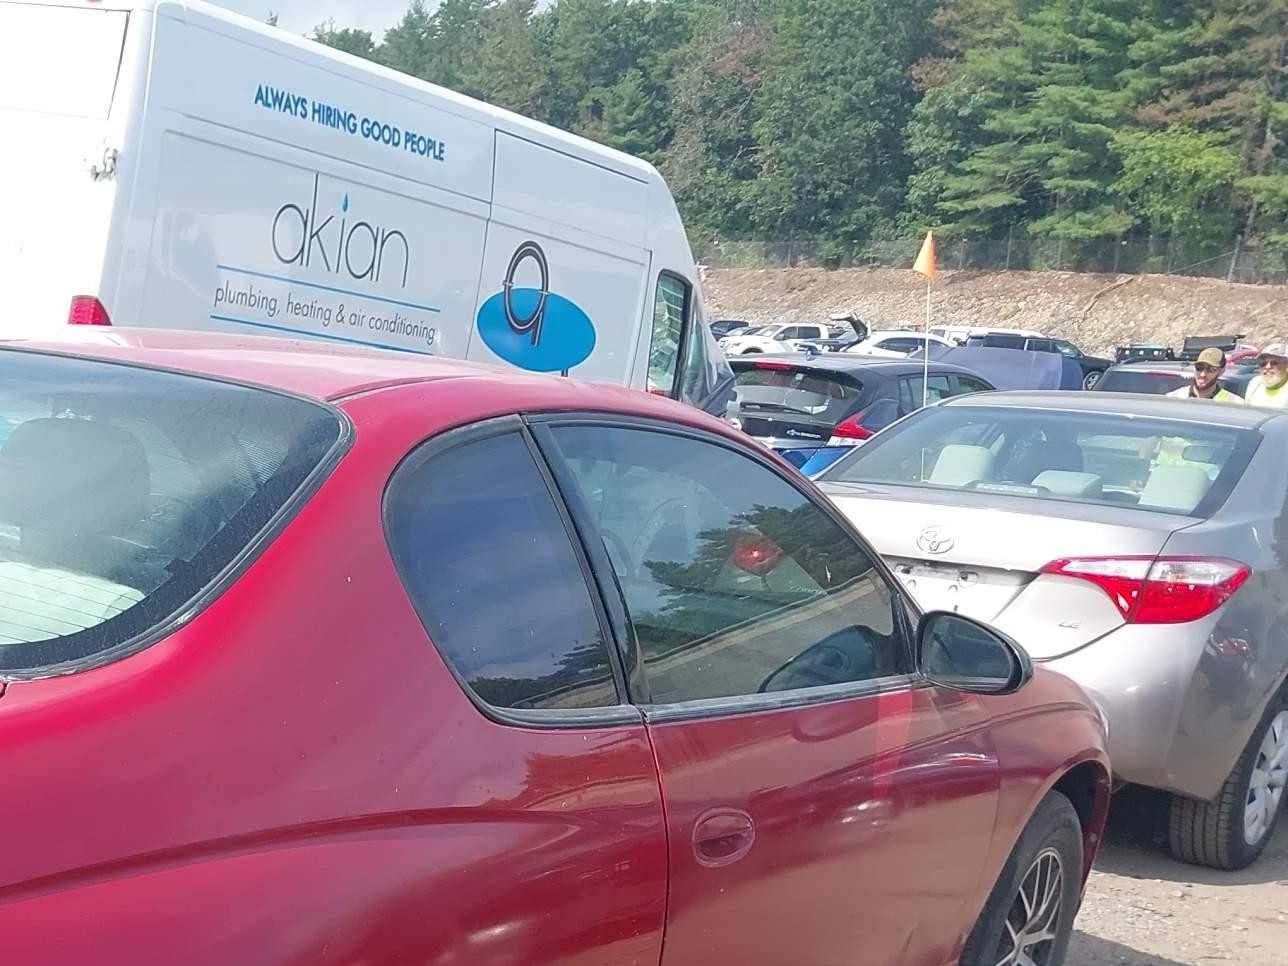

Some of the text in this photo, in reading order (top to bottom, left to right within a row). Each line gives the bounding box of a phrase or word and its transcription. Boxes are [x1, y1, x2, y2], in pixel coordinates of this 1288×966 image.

[255, 84, 445, 161] ALWAYS HIRING GOOD PEOPLE
[271, 171, 410, 288] akian
[214, 280, 436, 346] plumbing, heating & air conditioning
